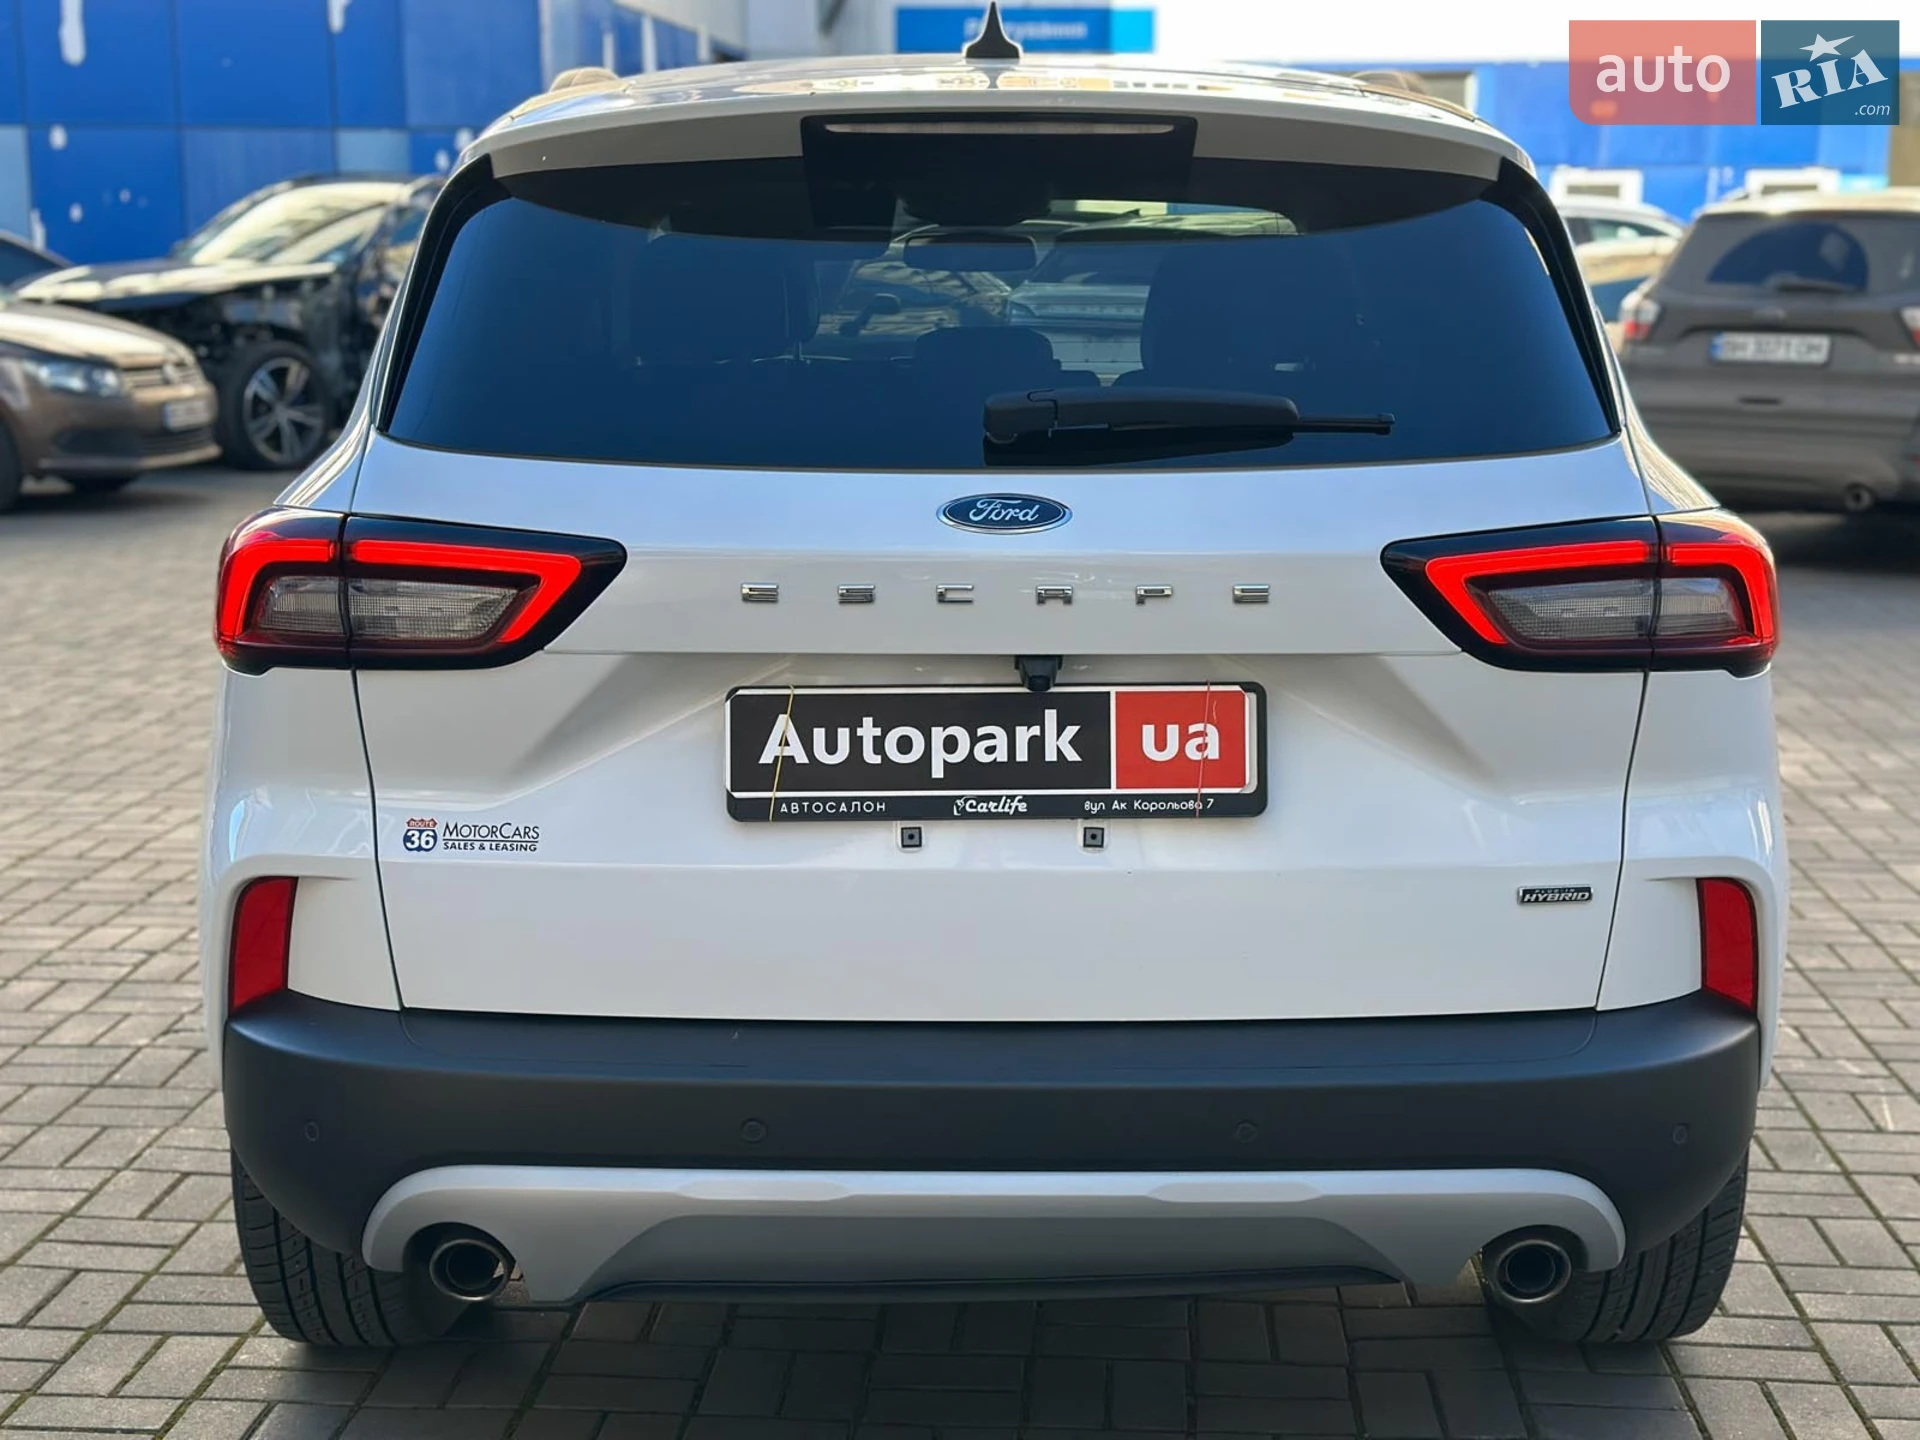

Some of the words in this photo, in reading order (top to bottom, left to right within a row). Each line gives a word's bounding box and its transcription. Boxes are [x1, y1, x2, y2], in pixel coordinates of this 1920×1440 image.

[969, 498, 1040, 521] Ford
[740, 582, 1271, 605] ESCAPE
[758, 709, 1083, 779] Autopark
[1141, 722, 1221, 762] ua
[780, 801, 886, 815] АВТОСАЛОН
[964, 796, 1028, 815] Carlife
[1111, 800, 1127, 811] Ак
[1206, 799, 1214, 809] 7
[409, 820, 435, 828] ROUTE
[405, 830, 435, 850] 36
[443, 841, 475, 851] SALES
[478, 842, 487, 851] &
[489, 842, 537, 852] LEASING
[1523, 892, 1590, 902] HYBRID
